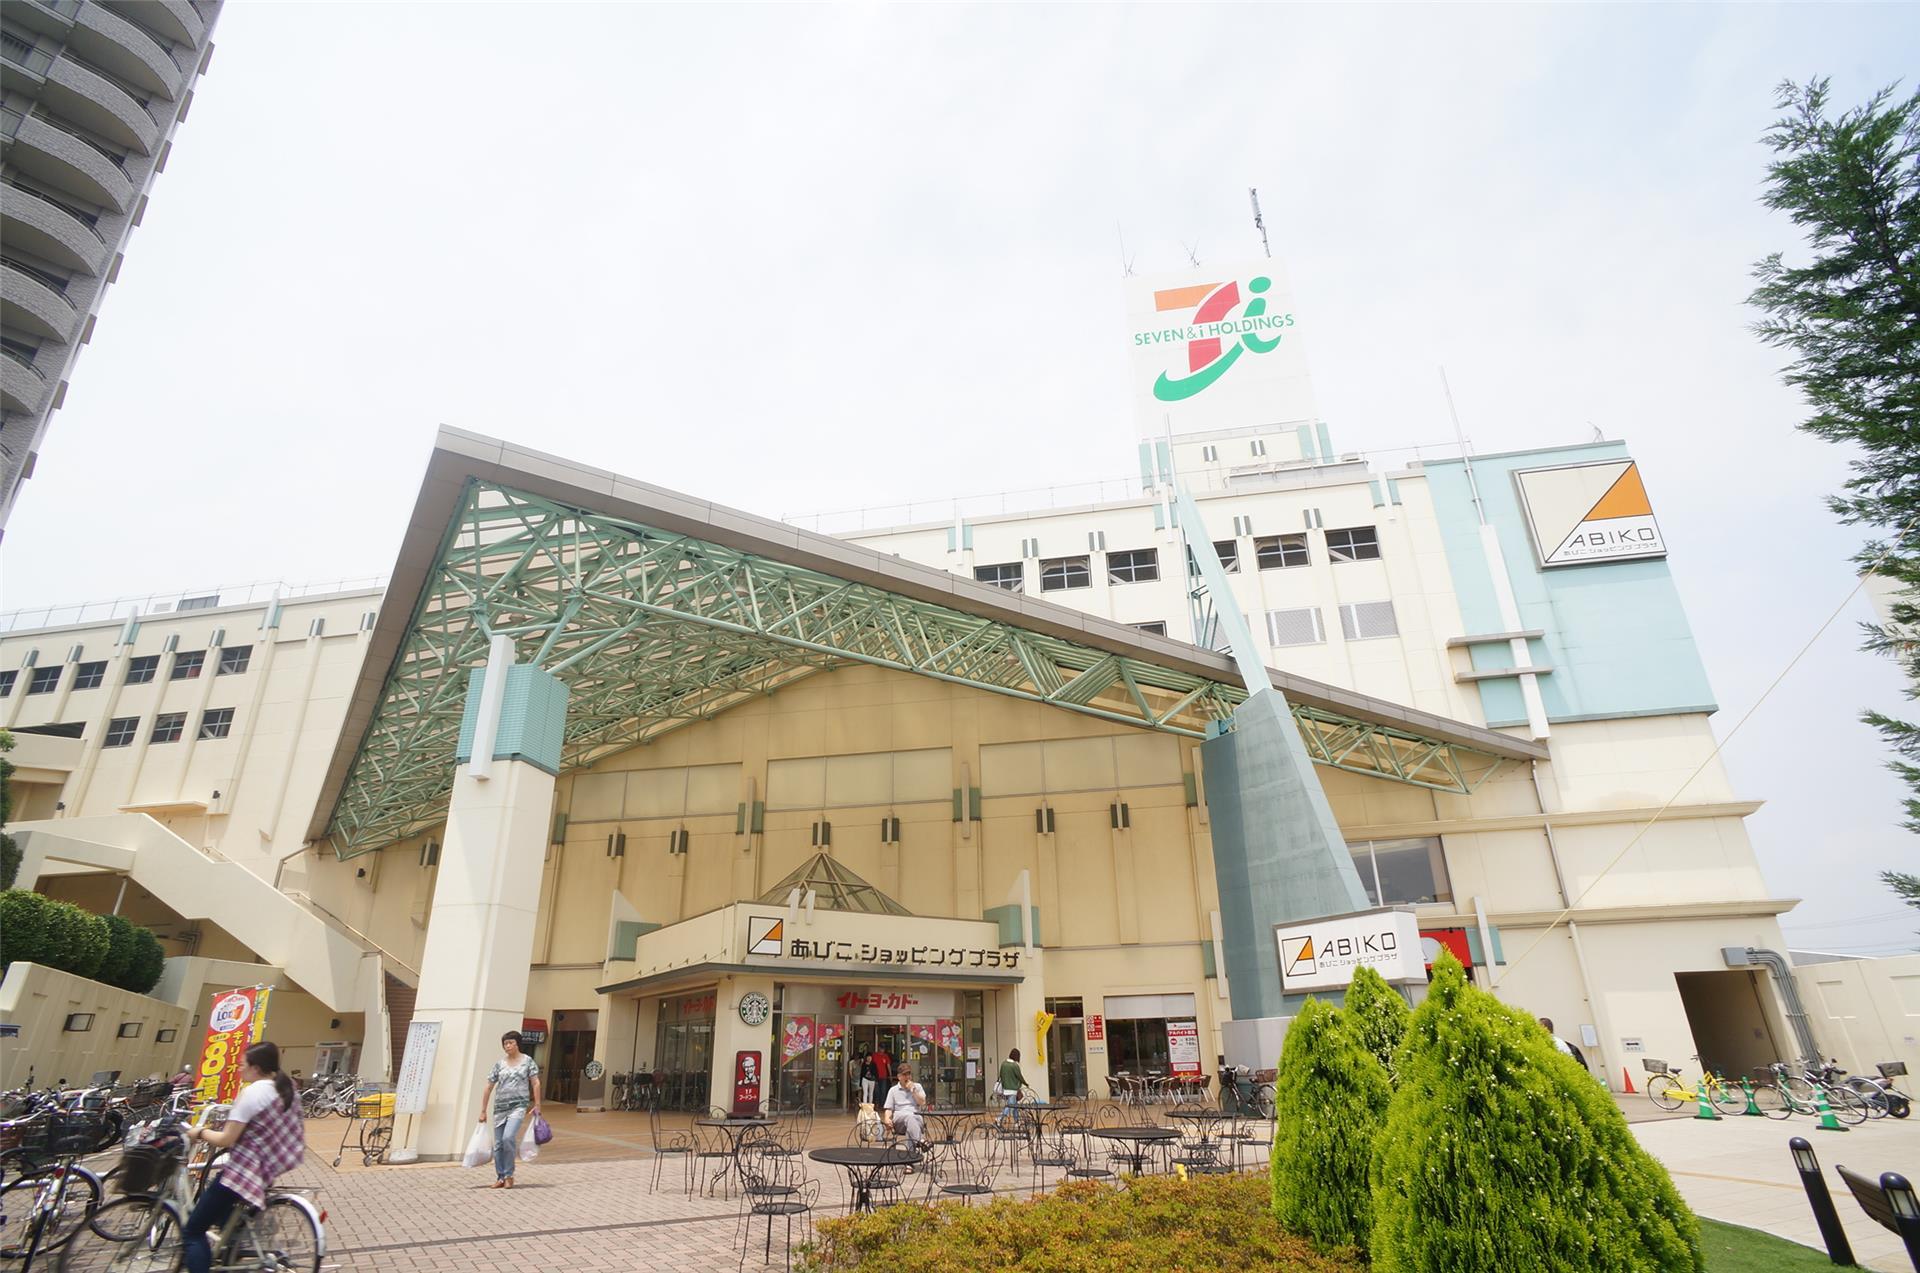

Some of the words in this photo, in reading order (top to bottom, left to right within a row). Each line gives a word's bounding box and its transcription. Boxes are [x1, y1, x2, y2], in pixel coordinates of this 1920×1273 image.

[1208, 313, 1295, 337] HOLDINGS
[1568, 527, 1655, 548] ABIKO
[1319, 932, 1397, 960] ABIKO
[837, 991, 919, 1010] イトーヨーカドー
